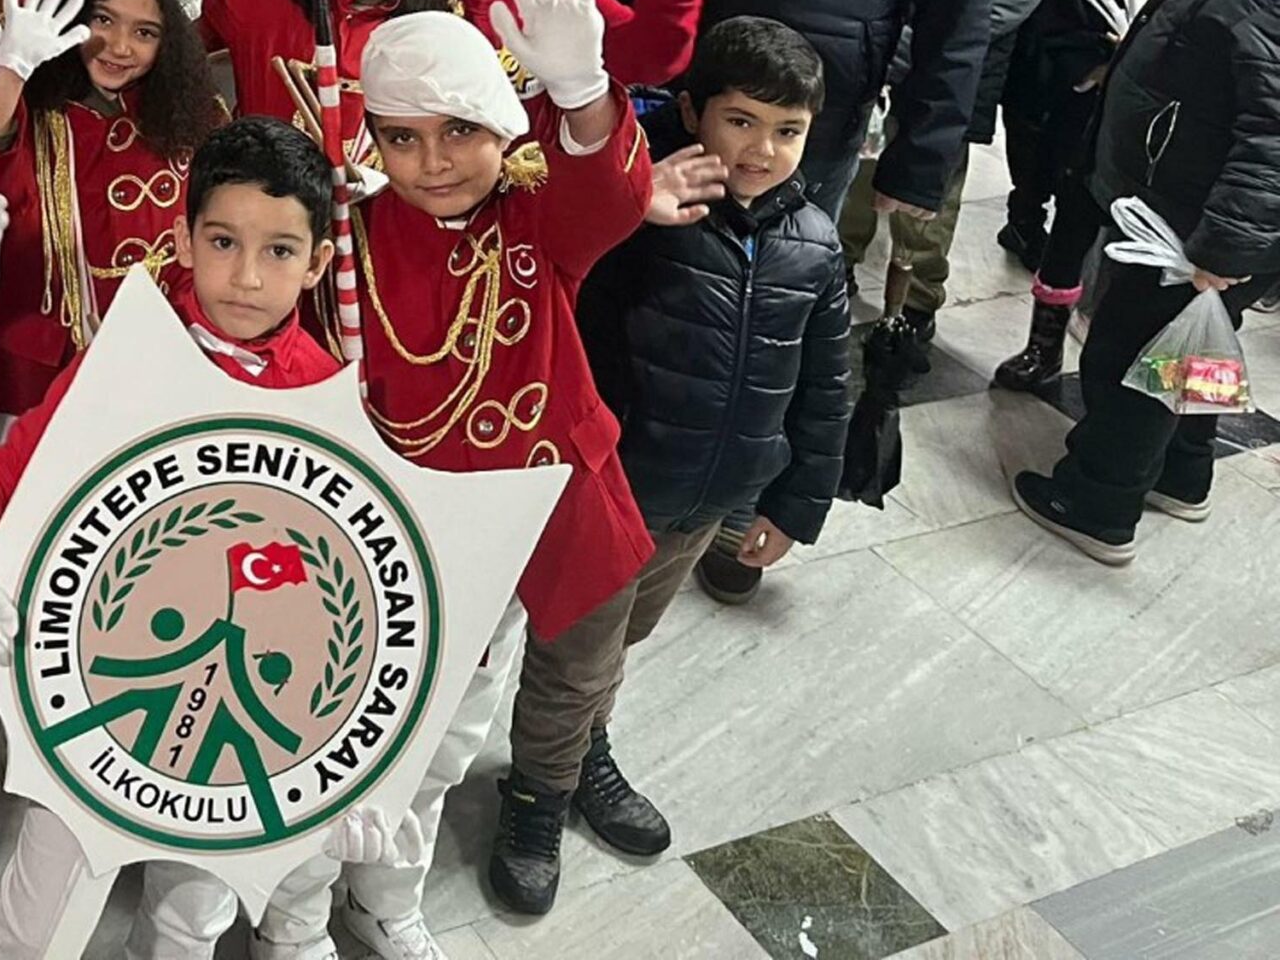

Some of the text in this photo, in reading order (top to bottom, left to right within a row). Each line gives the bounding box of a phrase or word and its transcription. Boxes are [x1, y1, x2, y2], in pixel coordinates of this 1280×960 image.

[348, 501, 416, 648] HASAN
[168, 661, 219, 769] 1981
[316, 662, 409, 794] SARAY
[88, 744, 249, 823] İLKOKULU
